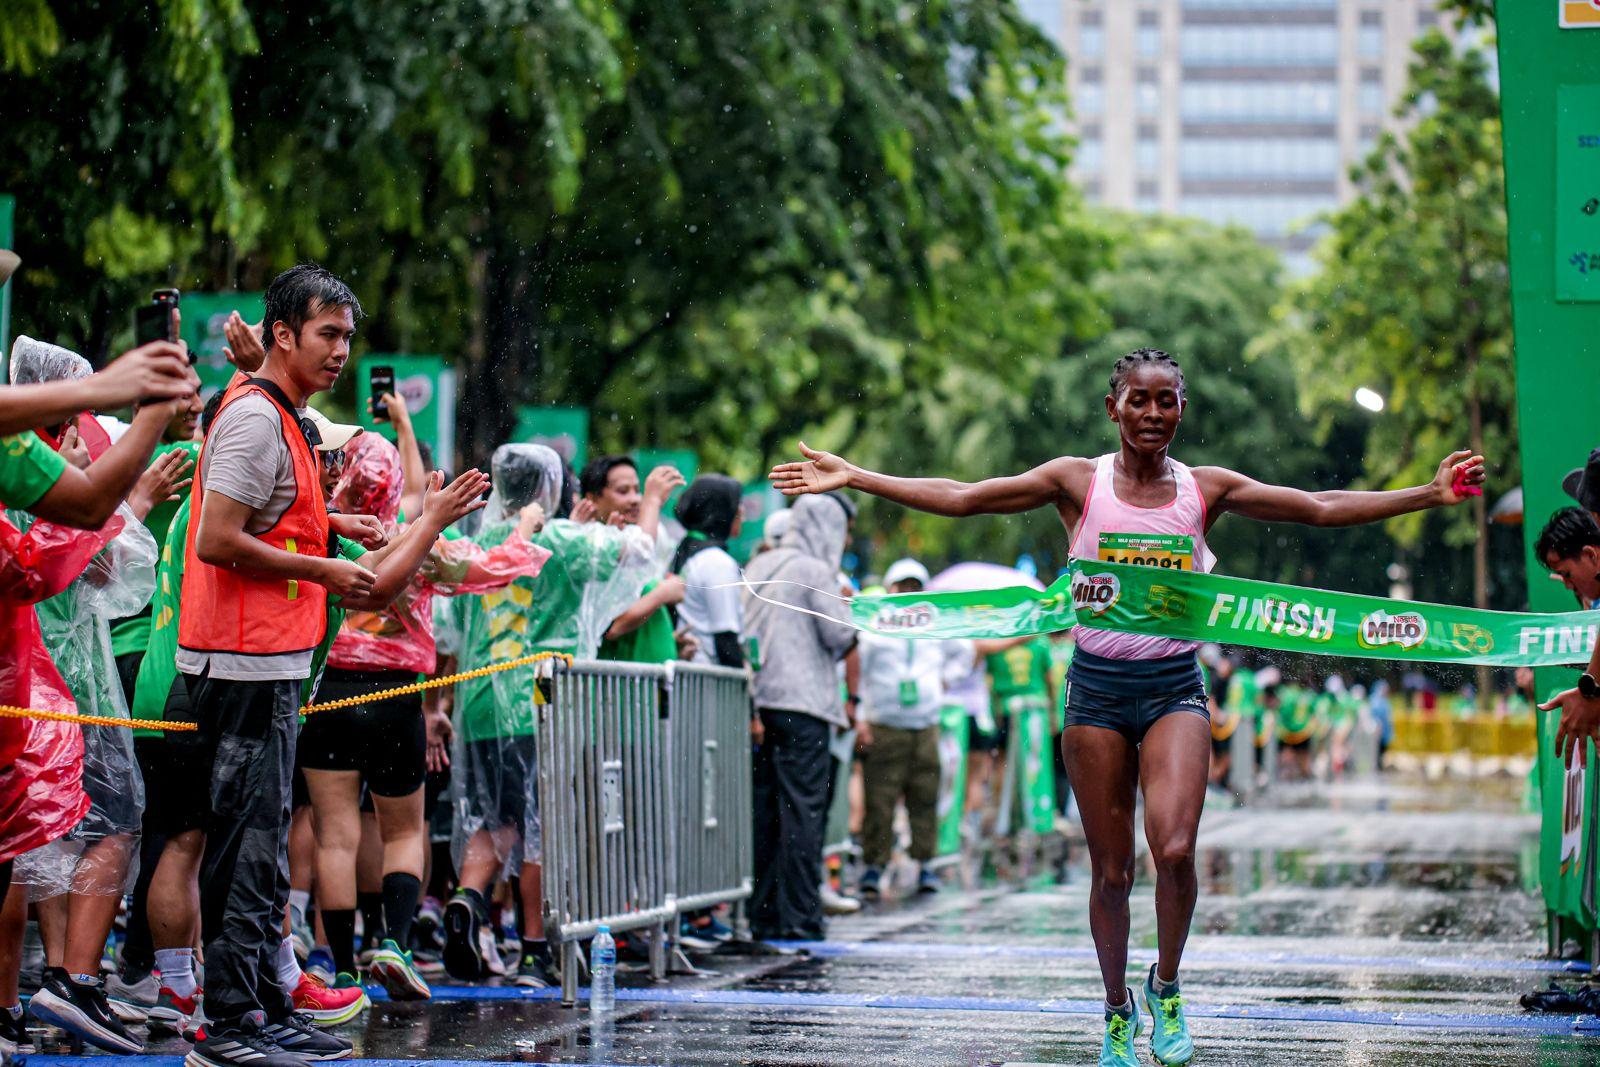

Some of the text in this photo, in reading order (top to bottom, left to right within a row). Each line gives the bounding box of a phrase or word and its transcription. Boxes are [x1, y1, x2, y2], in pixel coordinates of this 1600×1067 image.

[1072, 583, 1114, 604] MILO
[1207, 593, 1337, 640] FINISH
[1367, 621, 1421, 639] MILO
